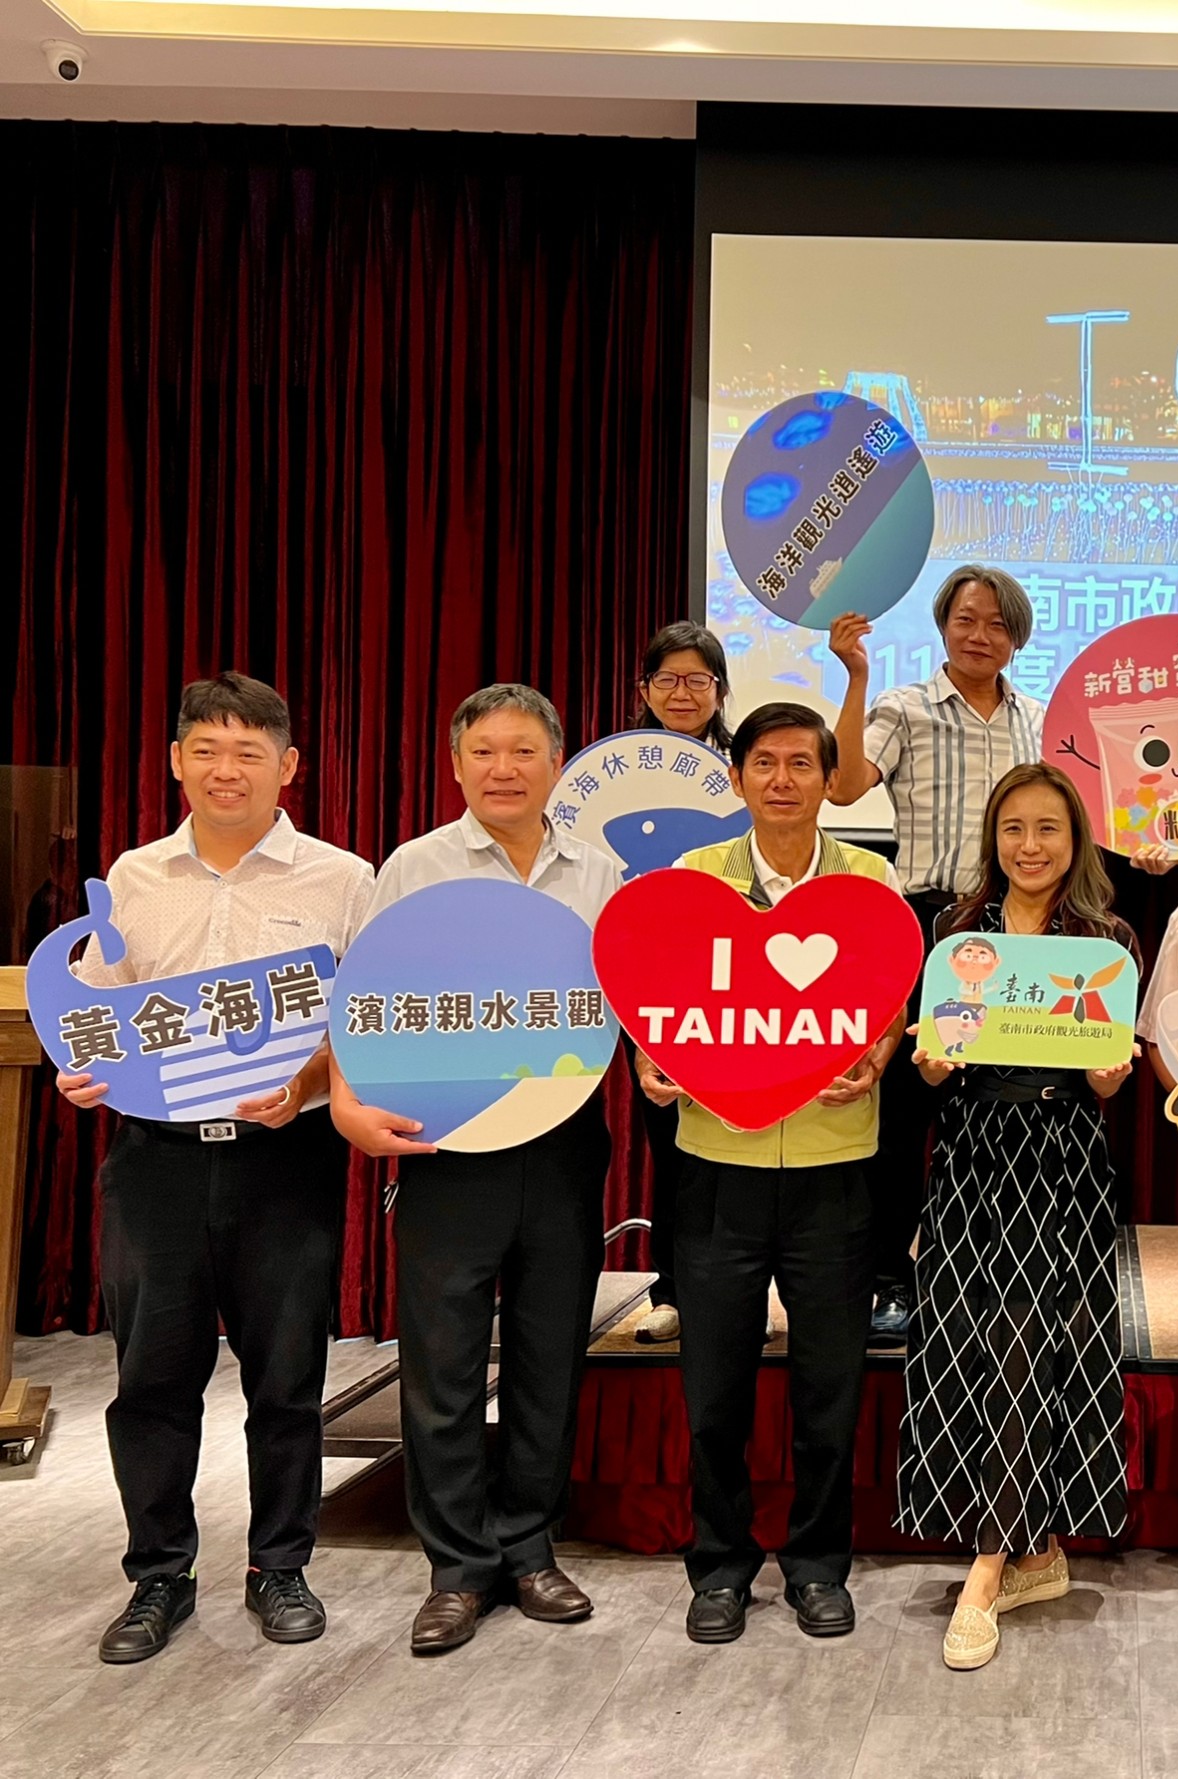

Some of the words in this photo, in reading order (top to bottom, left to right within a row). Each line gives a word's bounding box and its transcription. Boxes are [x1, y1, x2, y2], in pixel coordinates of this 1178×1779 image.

[756, 419, 899, 600] 海洋觀光逍遙遊
[551, 745, 731, 830] 濱海休憩廊帶
[711, 937, 732, 992] I
[60, 963, 327, 1072] 黃金海岸
[346, 989, 606, 1035] 濱海親水景觀
[638, 1007, 868, 1046] TAINAN
[1000, 1022, 1113, 1040] 臺南市政府觀光旅遊局
[1002, 1006, 1042, 1015] TAINAN
